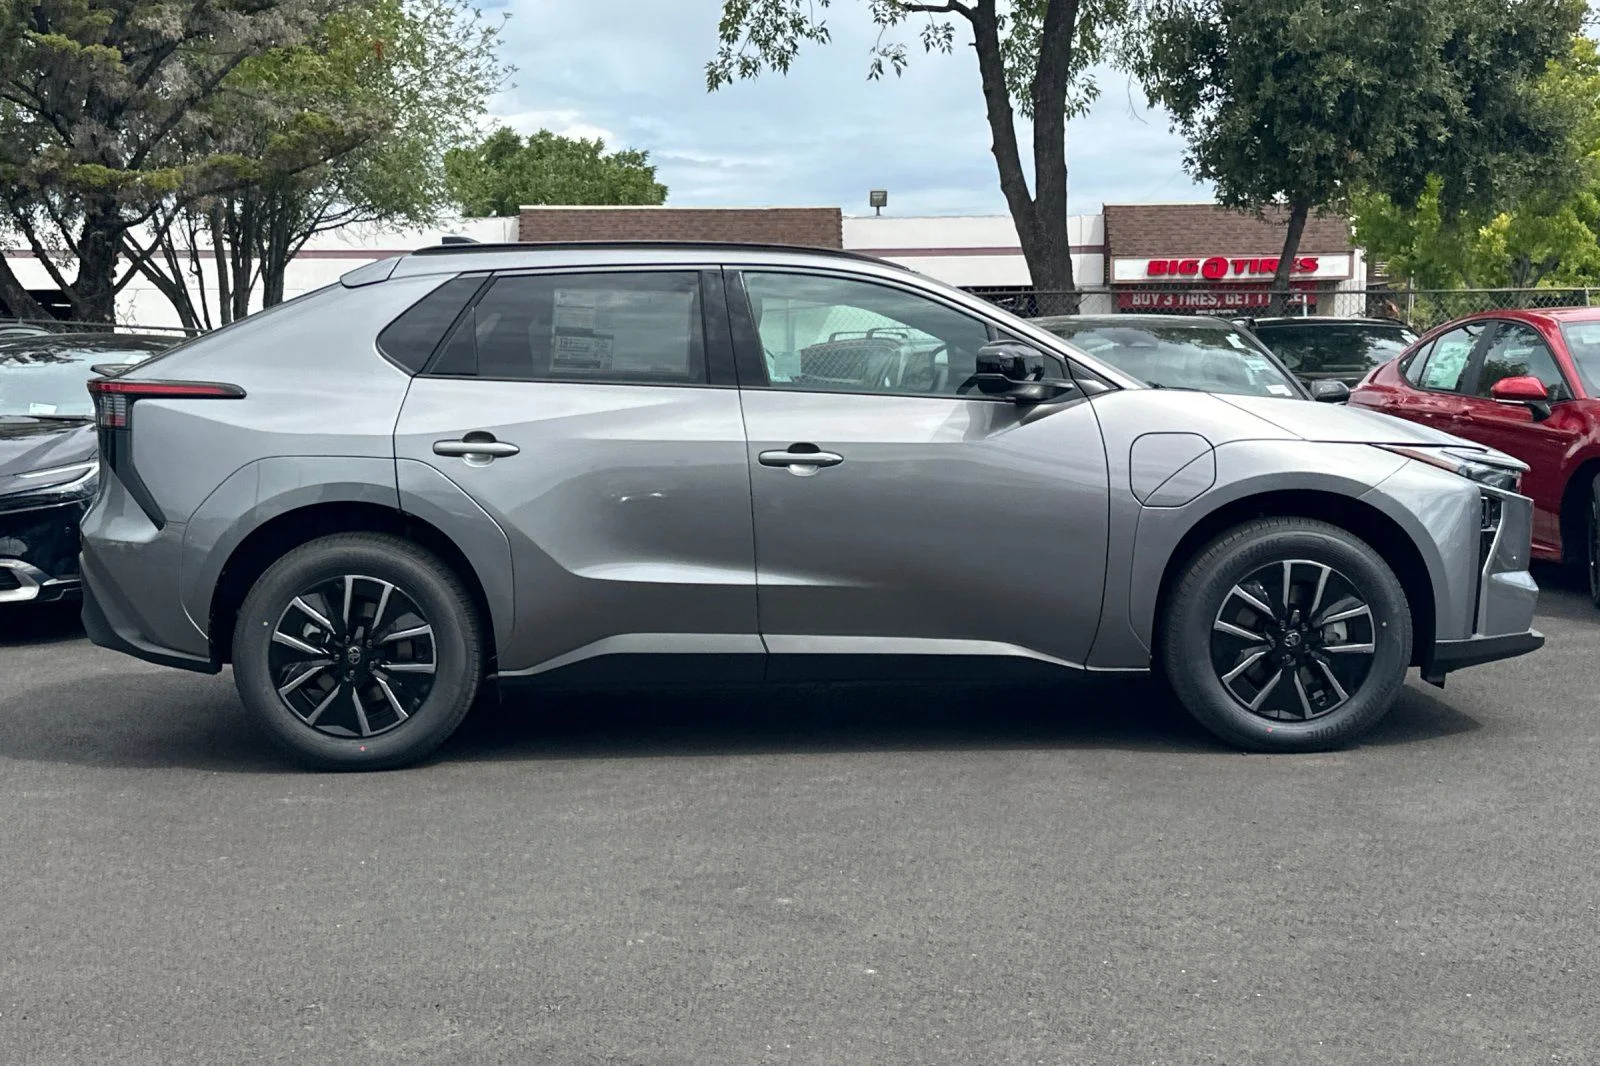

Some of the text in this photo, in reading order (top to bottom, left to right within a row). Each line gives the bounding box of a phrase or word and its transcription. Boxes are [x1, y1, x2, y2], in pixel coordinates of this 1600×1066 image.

[1147, 259, 1199, 275] BIG
[1132, 291, 1161, 305] BUY
[1164, 291, 1172, 305] 3
[1178, 290, 1221, 307] TIRES,
[1225, 291, 1250, 305] GET
